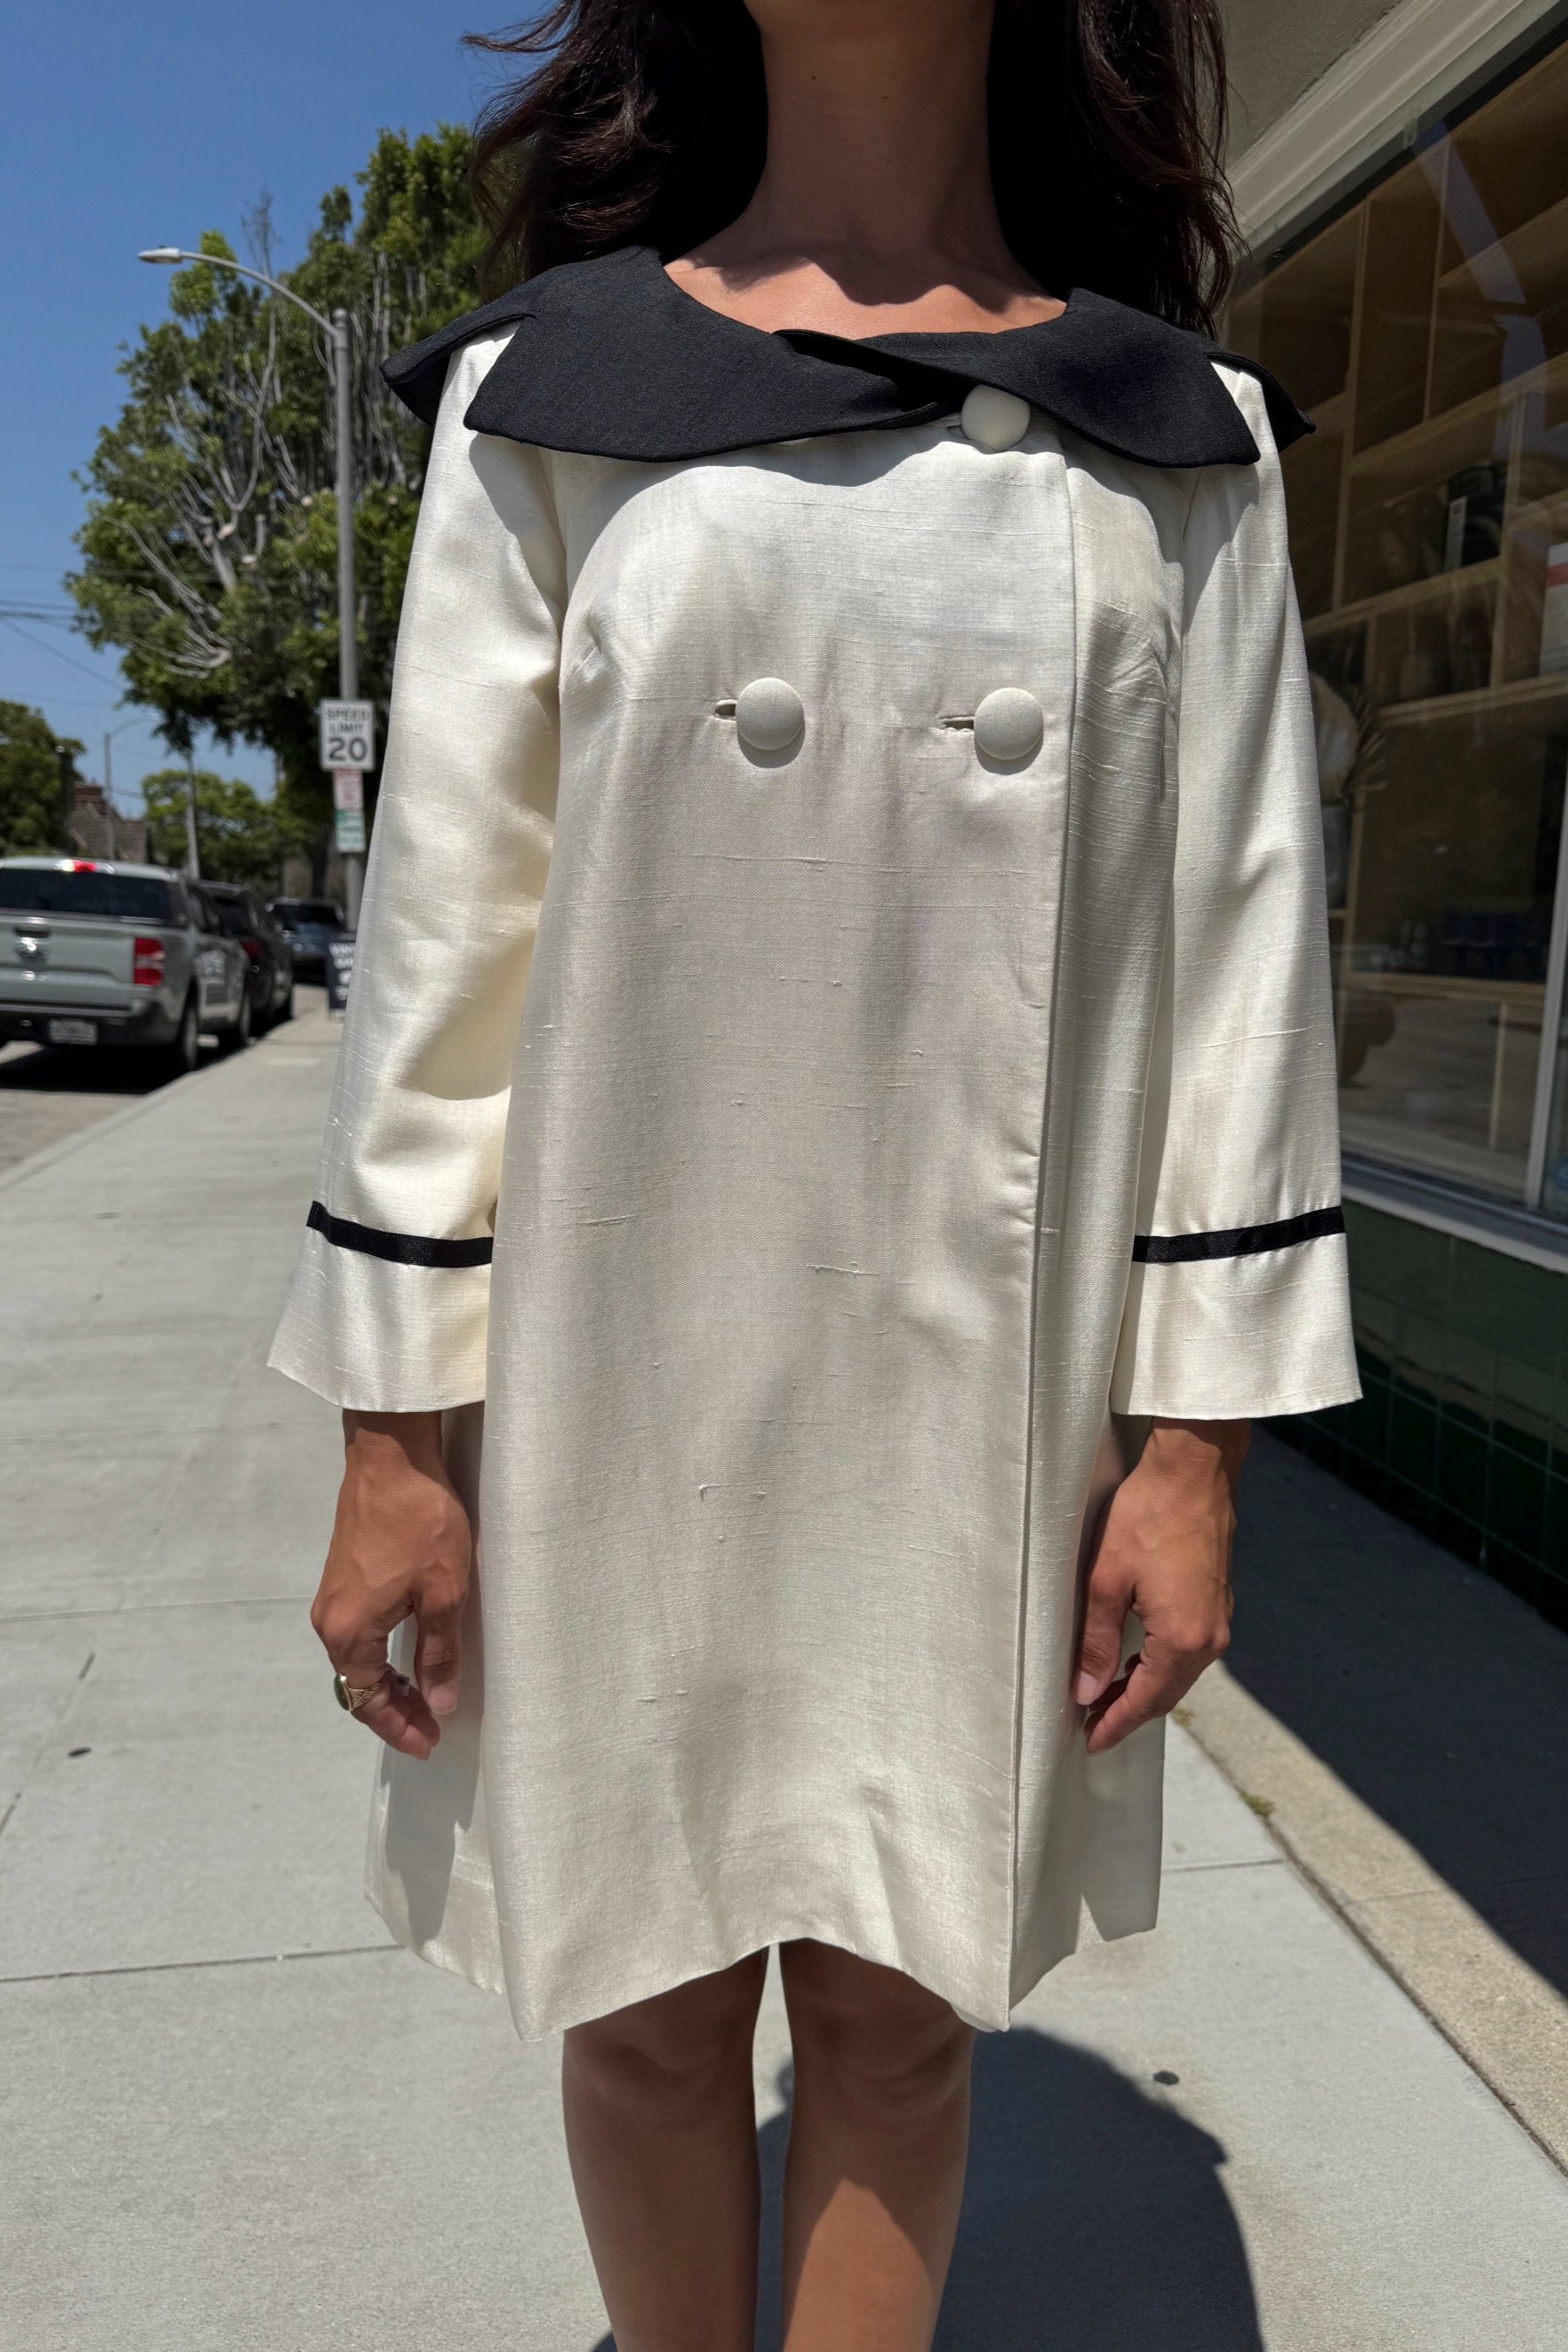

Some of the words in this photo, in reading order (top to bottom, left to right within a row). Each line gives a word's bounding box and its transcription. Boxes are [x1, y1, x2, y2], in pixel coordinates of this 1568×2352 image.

[327, 708, 370, 721] SPEED
[329, 723, 363, 733] LIMIT
[328, 737, 368, 761] 20
